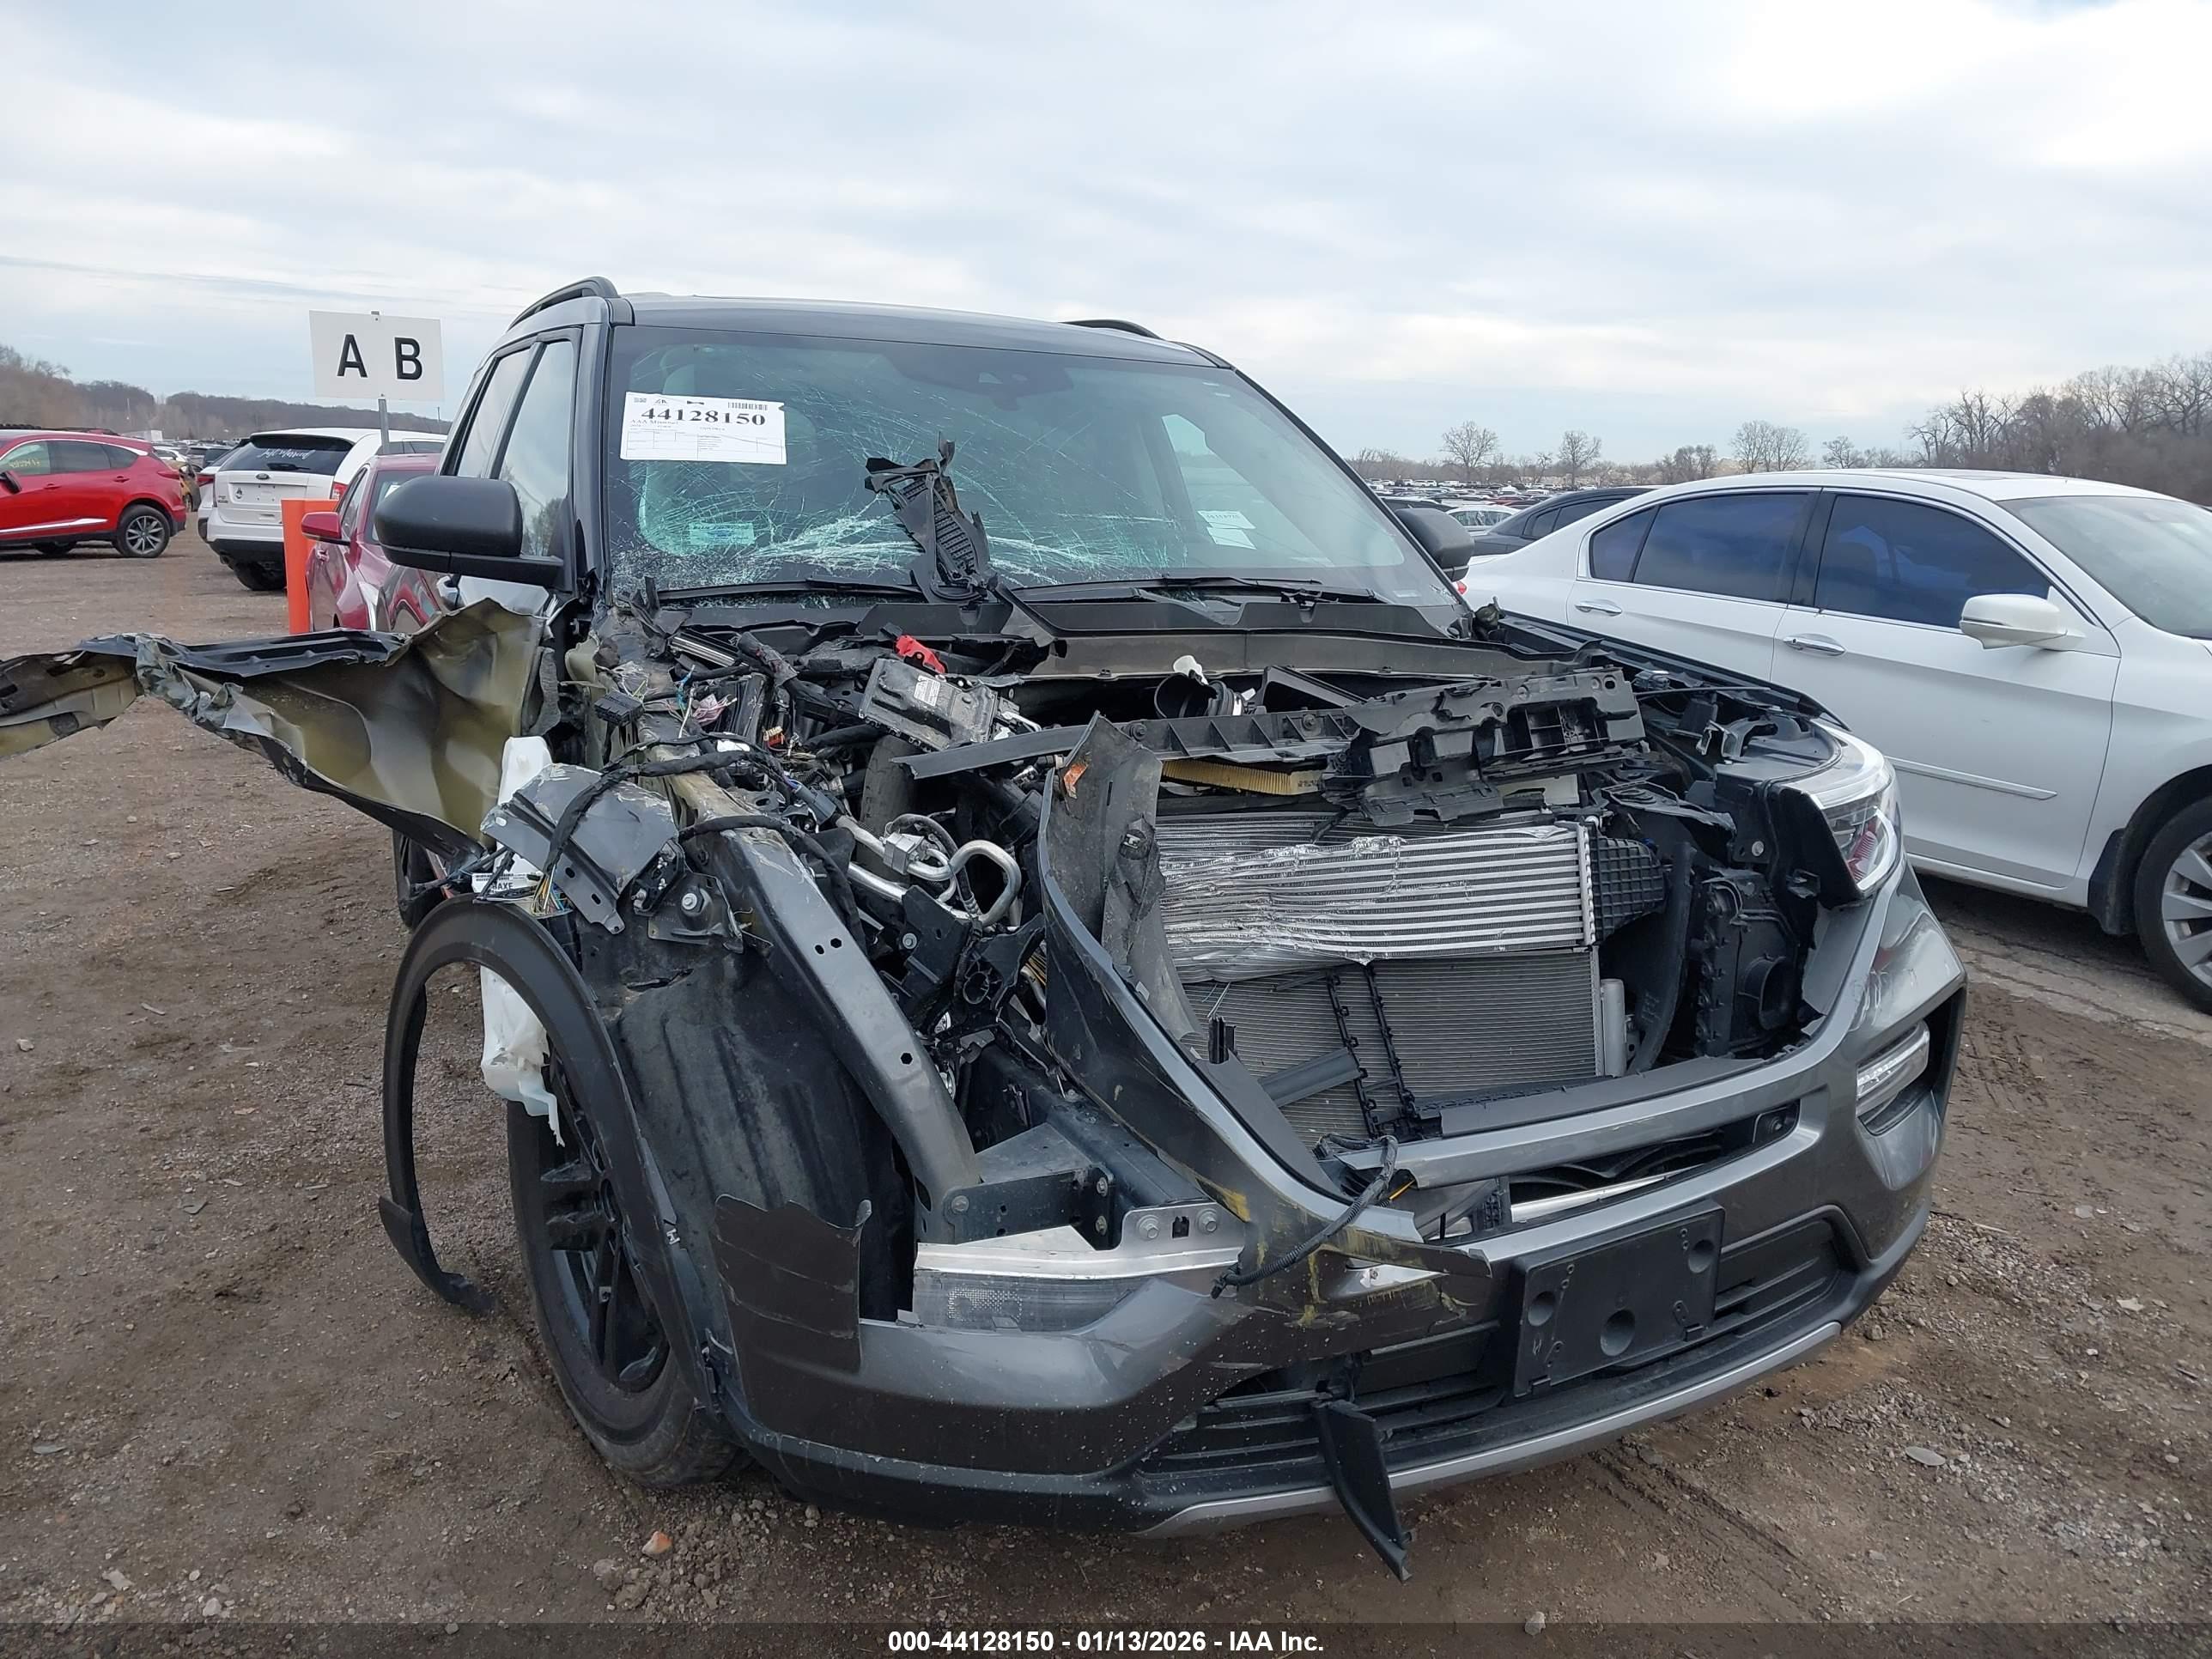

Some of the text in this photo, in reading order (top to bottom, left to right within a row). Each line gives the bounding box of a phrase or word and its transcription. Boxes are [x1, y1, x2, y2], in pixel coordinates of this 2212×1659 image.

[337, 333, 422, 380] A B
[641, 408, 766, 426] 44128150
